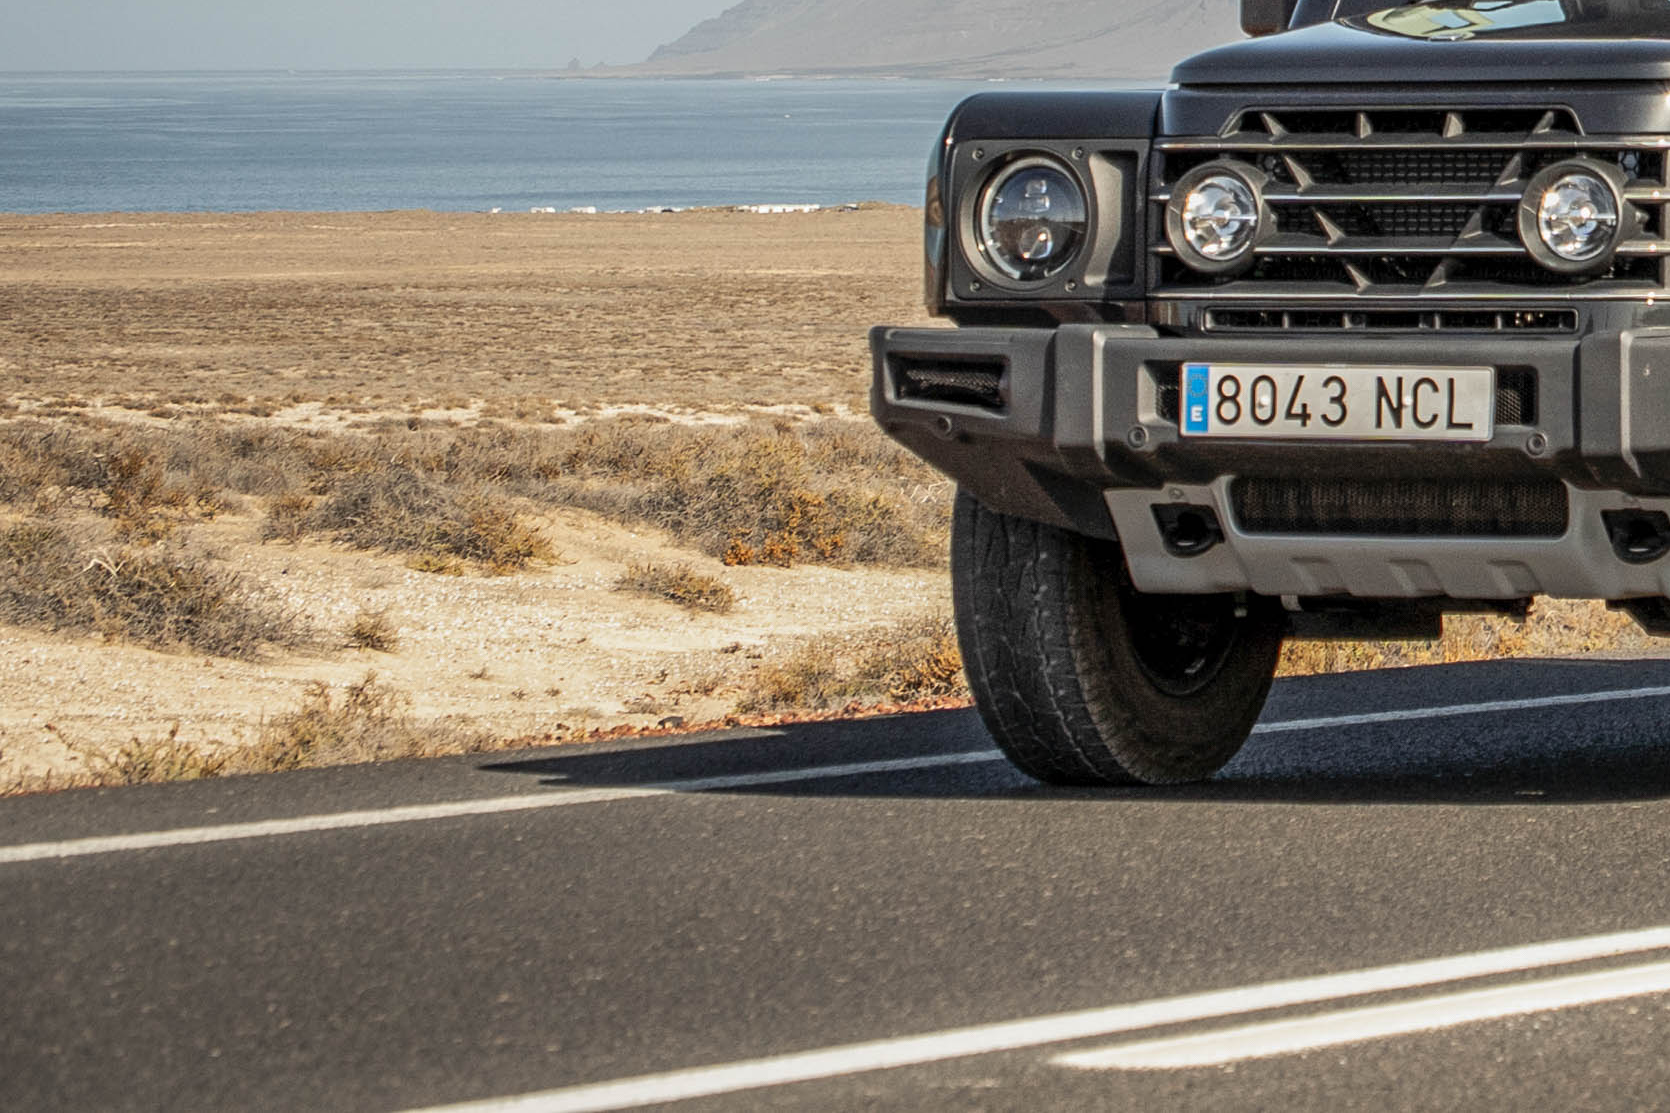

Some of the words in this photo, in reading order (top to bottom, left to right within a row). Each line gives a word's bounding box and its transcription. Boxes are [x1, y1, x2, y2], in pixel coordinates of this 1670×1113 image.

[1190, 406, 1203, 422] E
[1216, 374, 1348, 427] 8043
[1375, 376, 1474, 430] NCL
